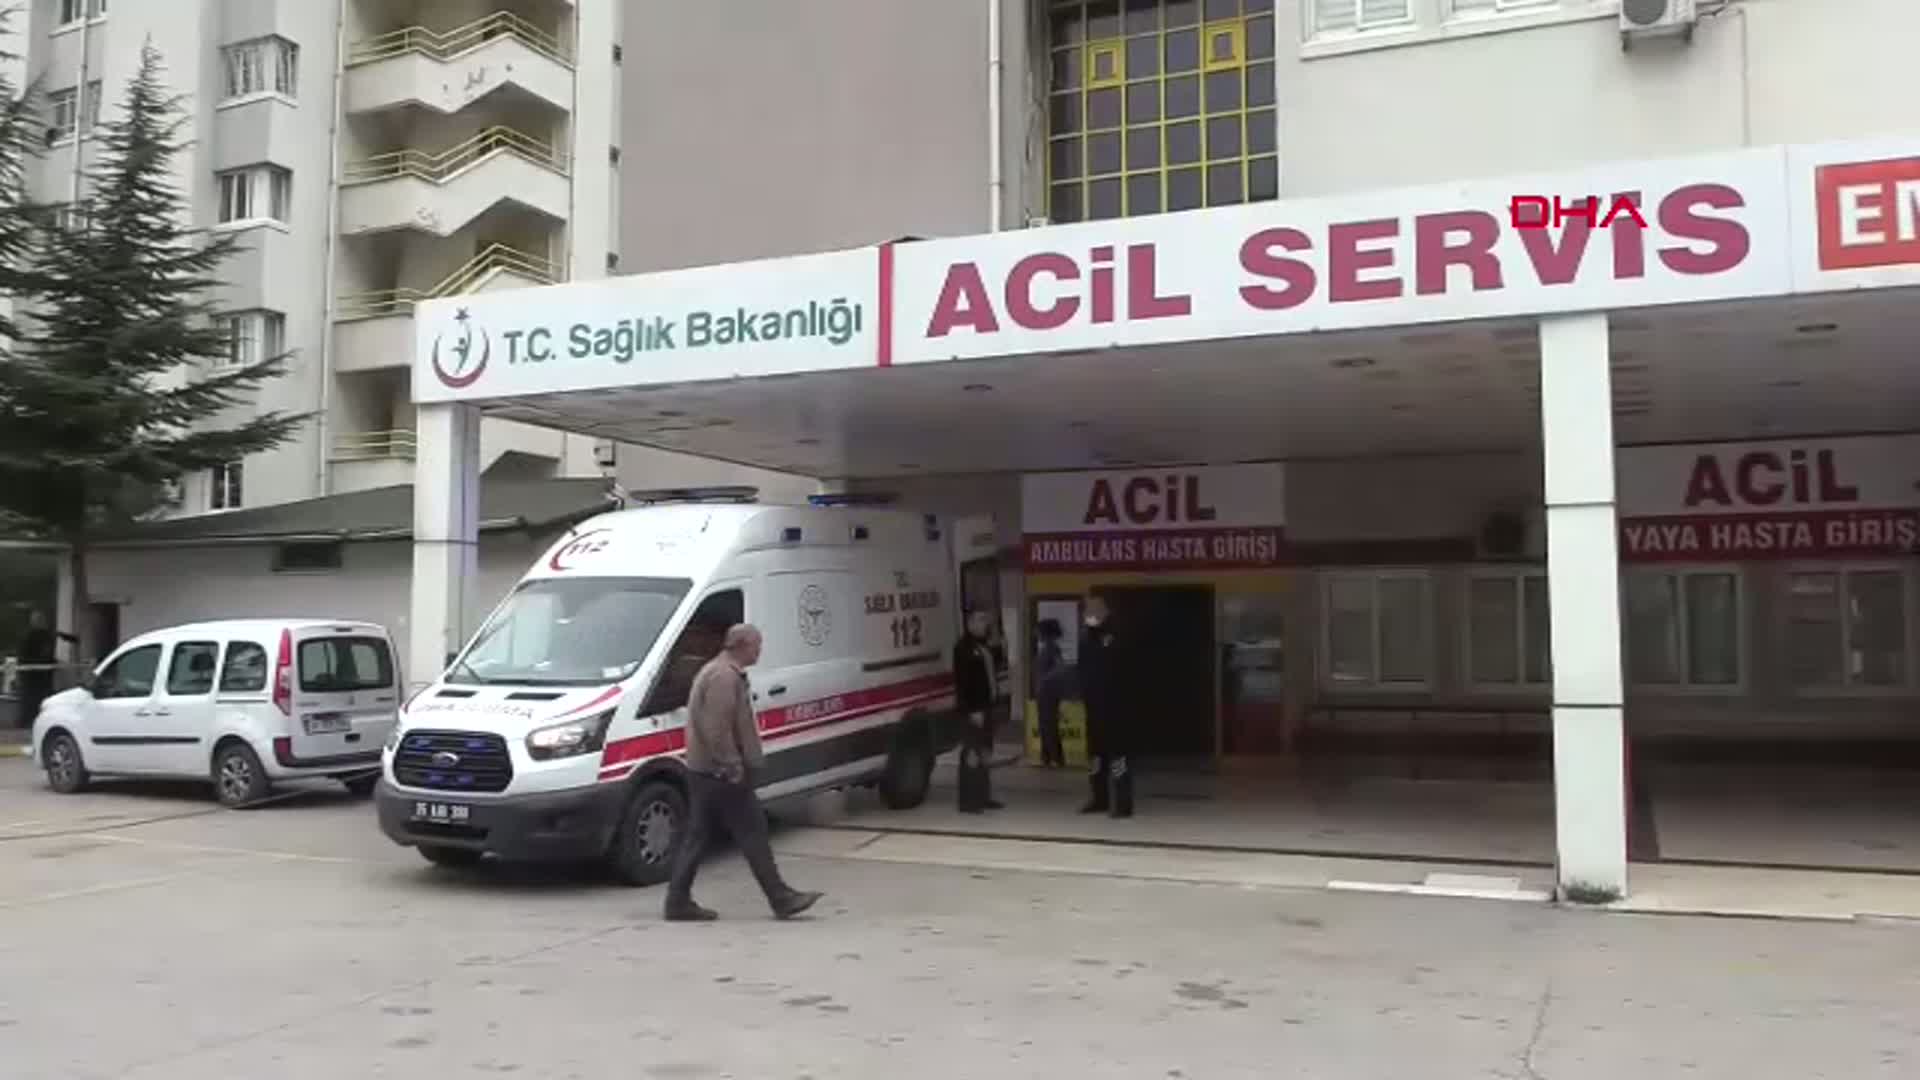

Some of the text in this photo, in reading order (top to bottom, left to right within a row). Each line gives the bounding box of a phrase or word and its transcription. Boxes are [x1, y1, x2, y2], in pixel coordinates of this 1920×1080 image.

[503, 297, 863, 364] T.C. Sağlık Bakanlığı
[1031, 530, 1277, 564] AMBULANS HASTA GİRİŞİ
[1624, 513, 1920, 552] YAYA HASTA GİRİŞ
[890, 615, 922, 649] 112
